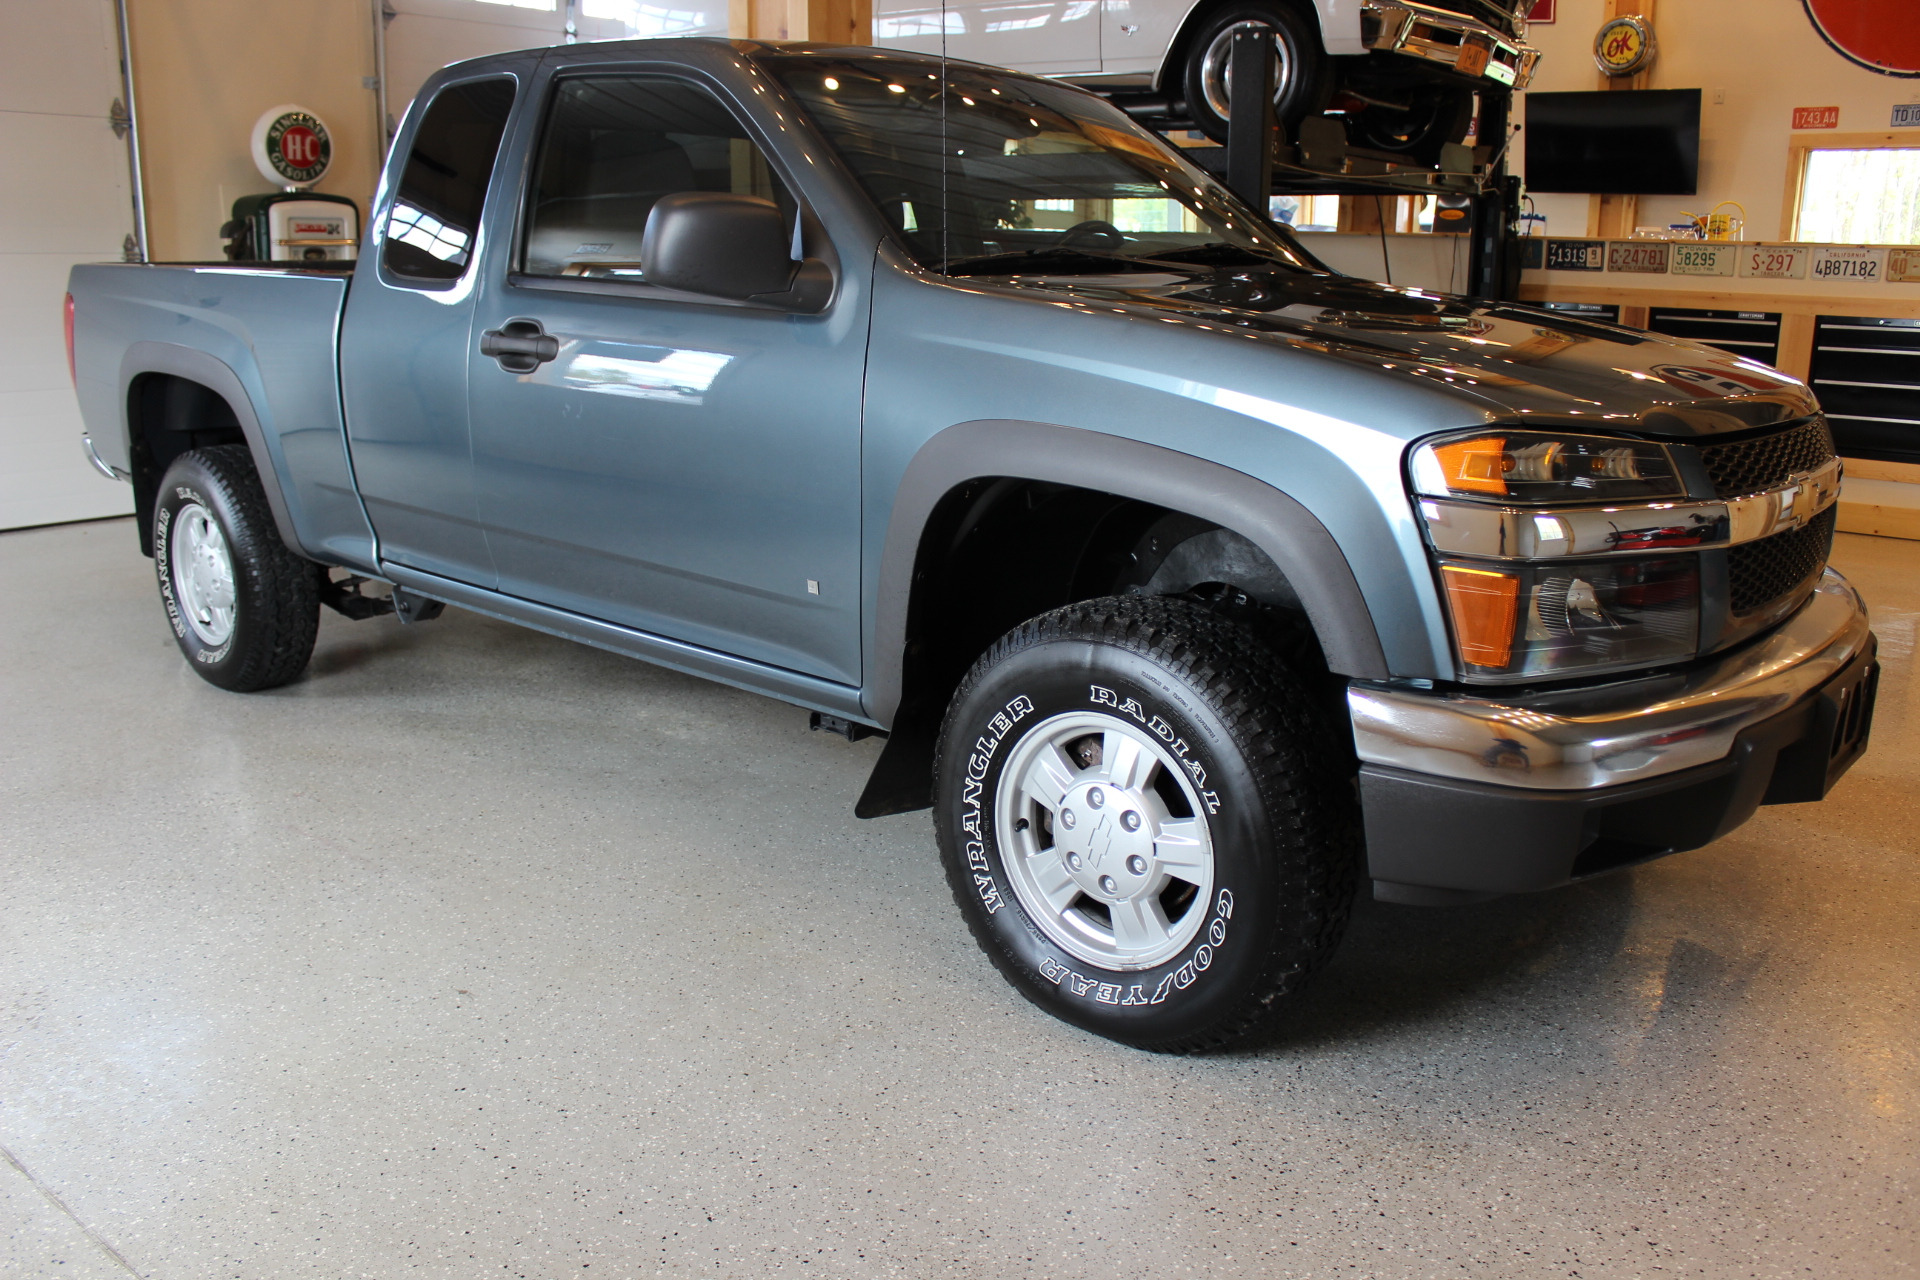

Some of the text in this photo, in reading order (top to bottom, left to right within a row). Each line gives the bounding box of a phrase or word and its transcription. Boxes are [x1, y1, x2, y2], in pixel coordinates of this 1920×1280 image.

[1607, 30, 1634, 58] OK
[1795, 111, 1836, 125] 1743 AA
[271, 152, 328, 180] GASOLINE
[1557, 248, 1586, 263] 1319
[1684, 251, 1716, 267] 8295
[1814, 259, 1877, 277] 4B87182
[1090, 684, 1223, 815] RADIAL
[962, 695, 1035, 914] WRANGLER
